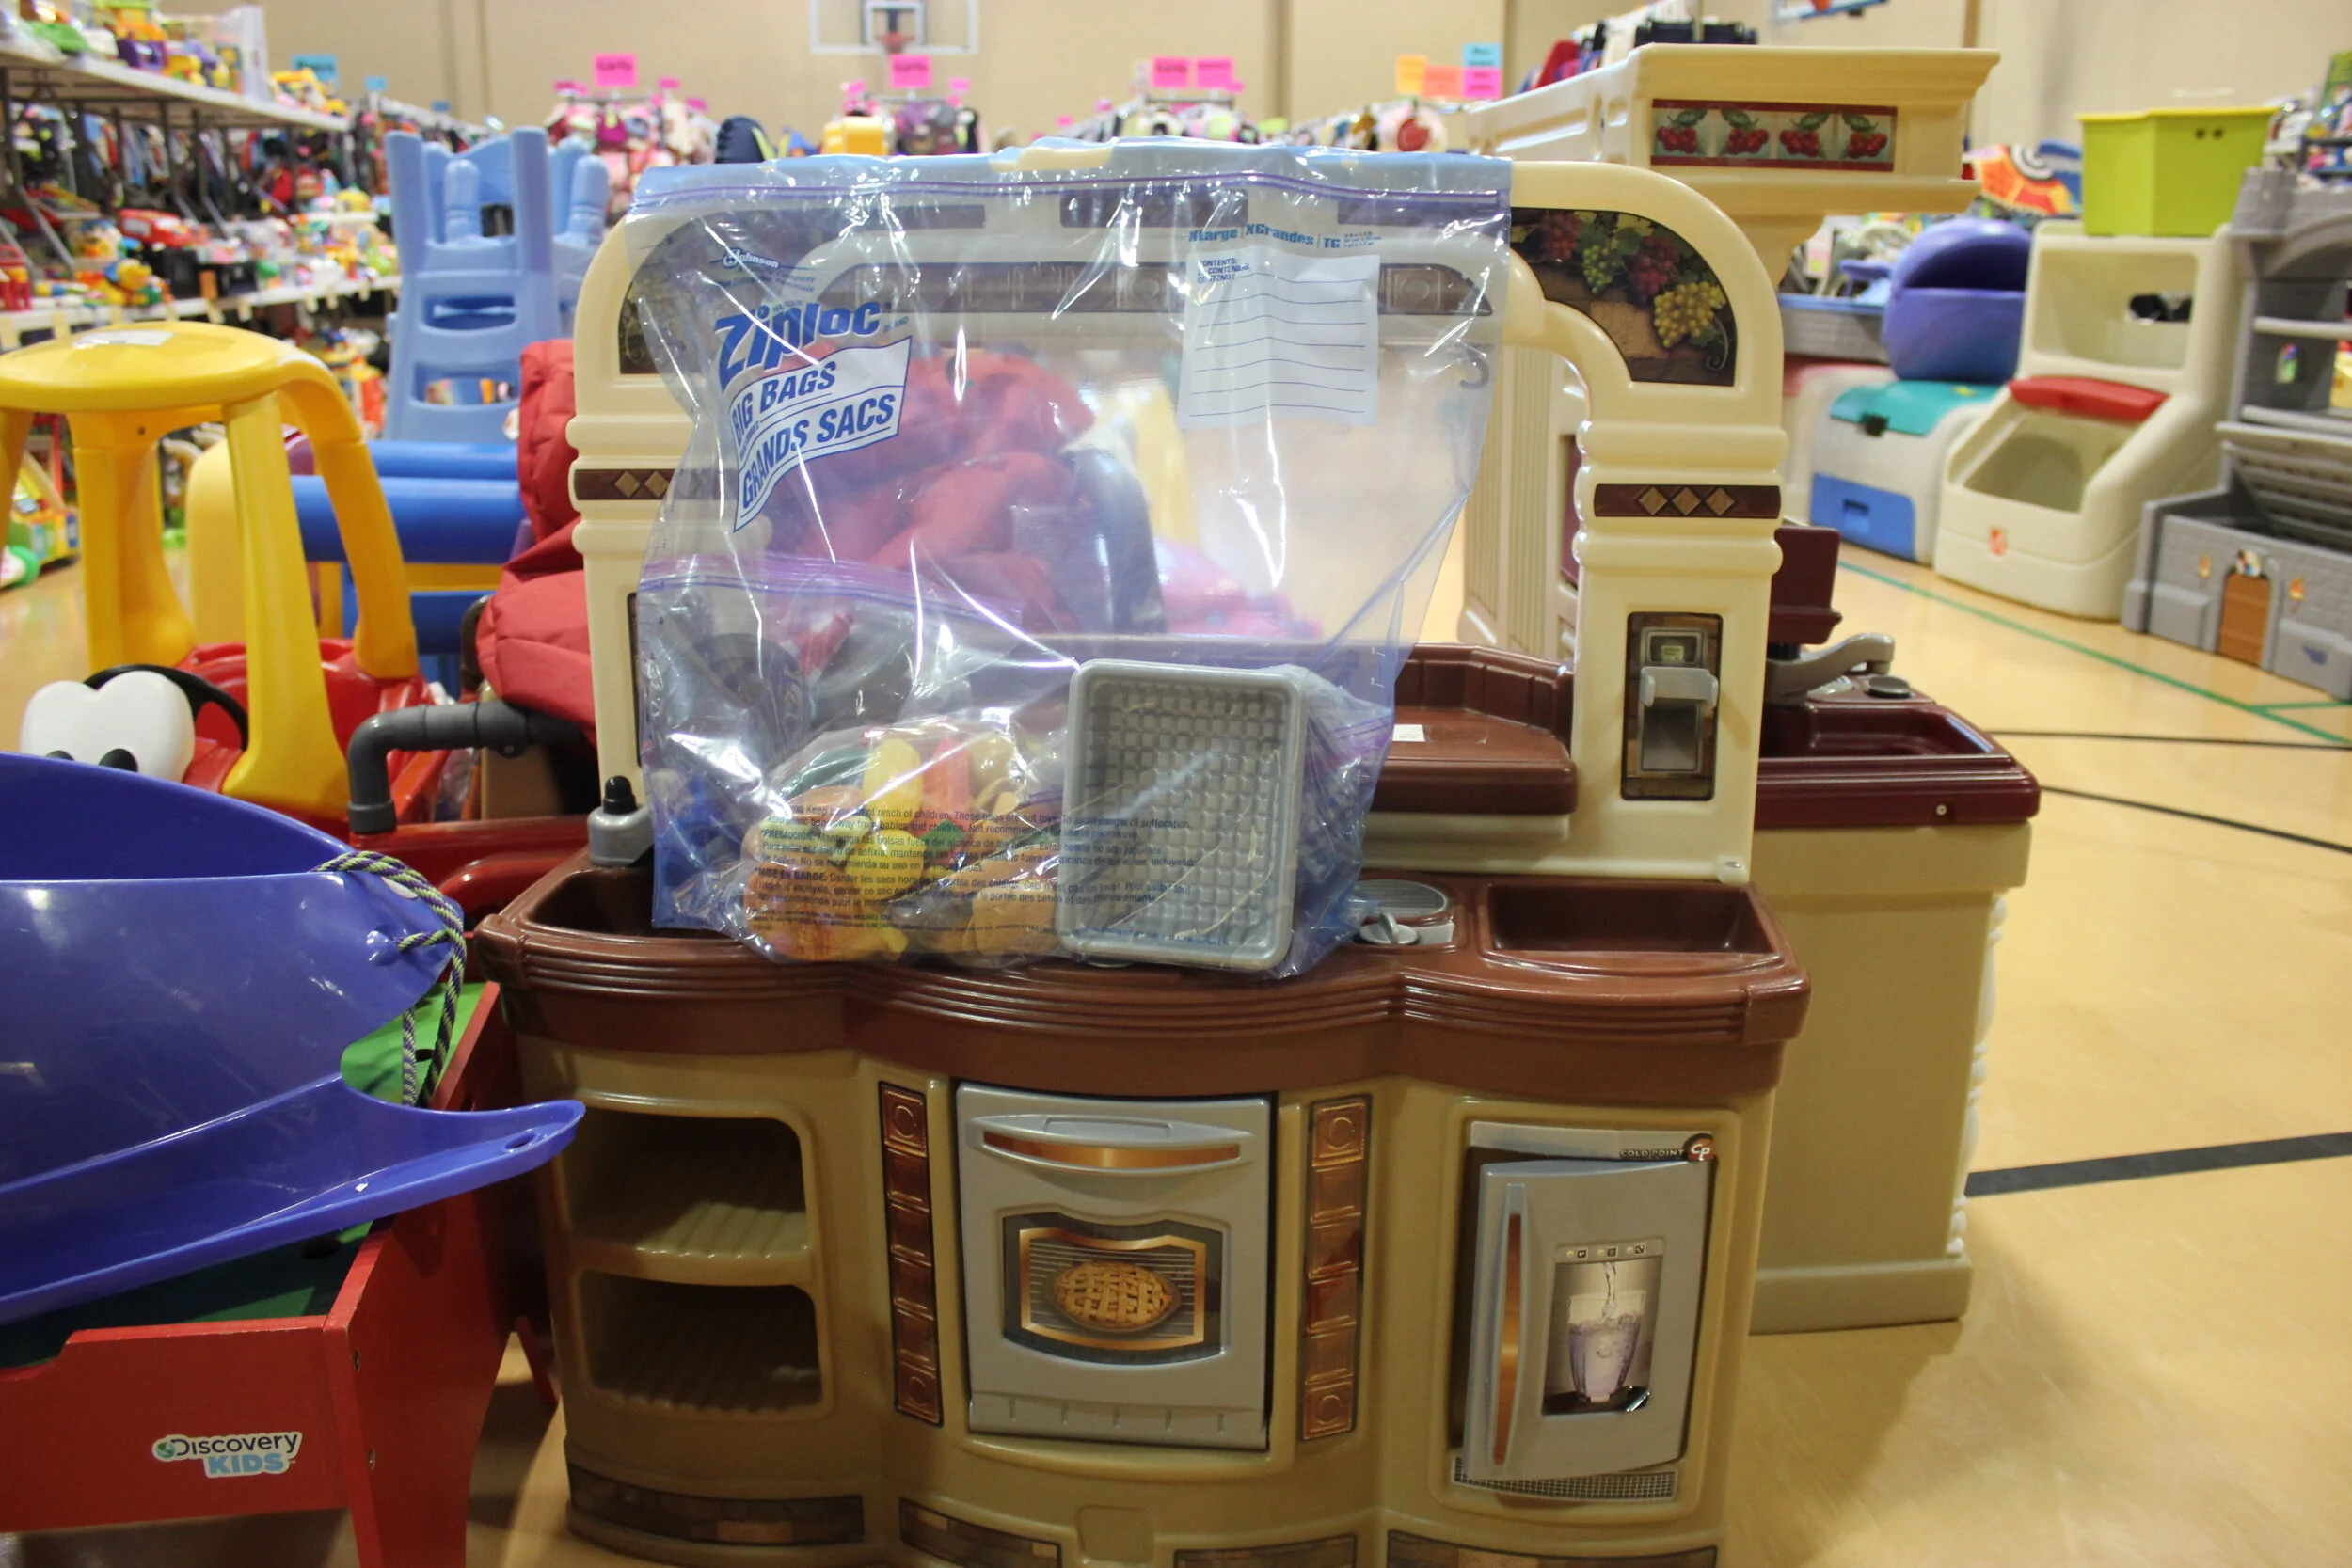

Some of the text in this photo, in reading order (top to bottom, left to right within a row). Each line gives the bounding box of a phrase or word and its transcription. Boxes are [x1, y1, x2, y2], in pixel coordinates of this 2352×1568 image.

[1246, 224, 1314, 245] XGrandes
[1324, 237, 1341, 248] TG
[715, 302, 882, 394] Ziploc
[731, 391, 754, 448] BIG
[760, 361, 836, 414] BAGS
[743, 420, 809, 509] GRANDS
[817, 393, 896, 444] SACS
[806, 806, 828, 816] Keep
[878, 808, 901, 818] reach
[903, 809, 913, 817] of
[1620, 1149, 1649, 1158] COLD
[1651, 1148, 1685, 1158] POINT
[169, 1433, 298, 1456] Discovery
[207, 1452, 285, 1475] KIDS
